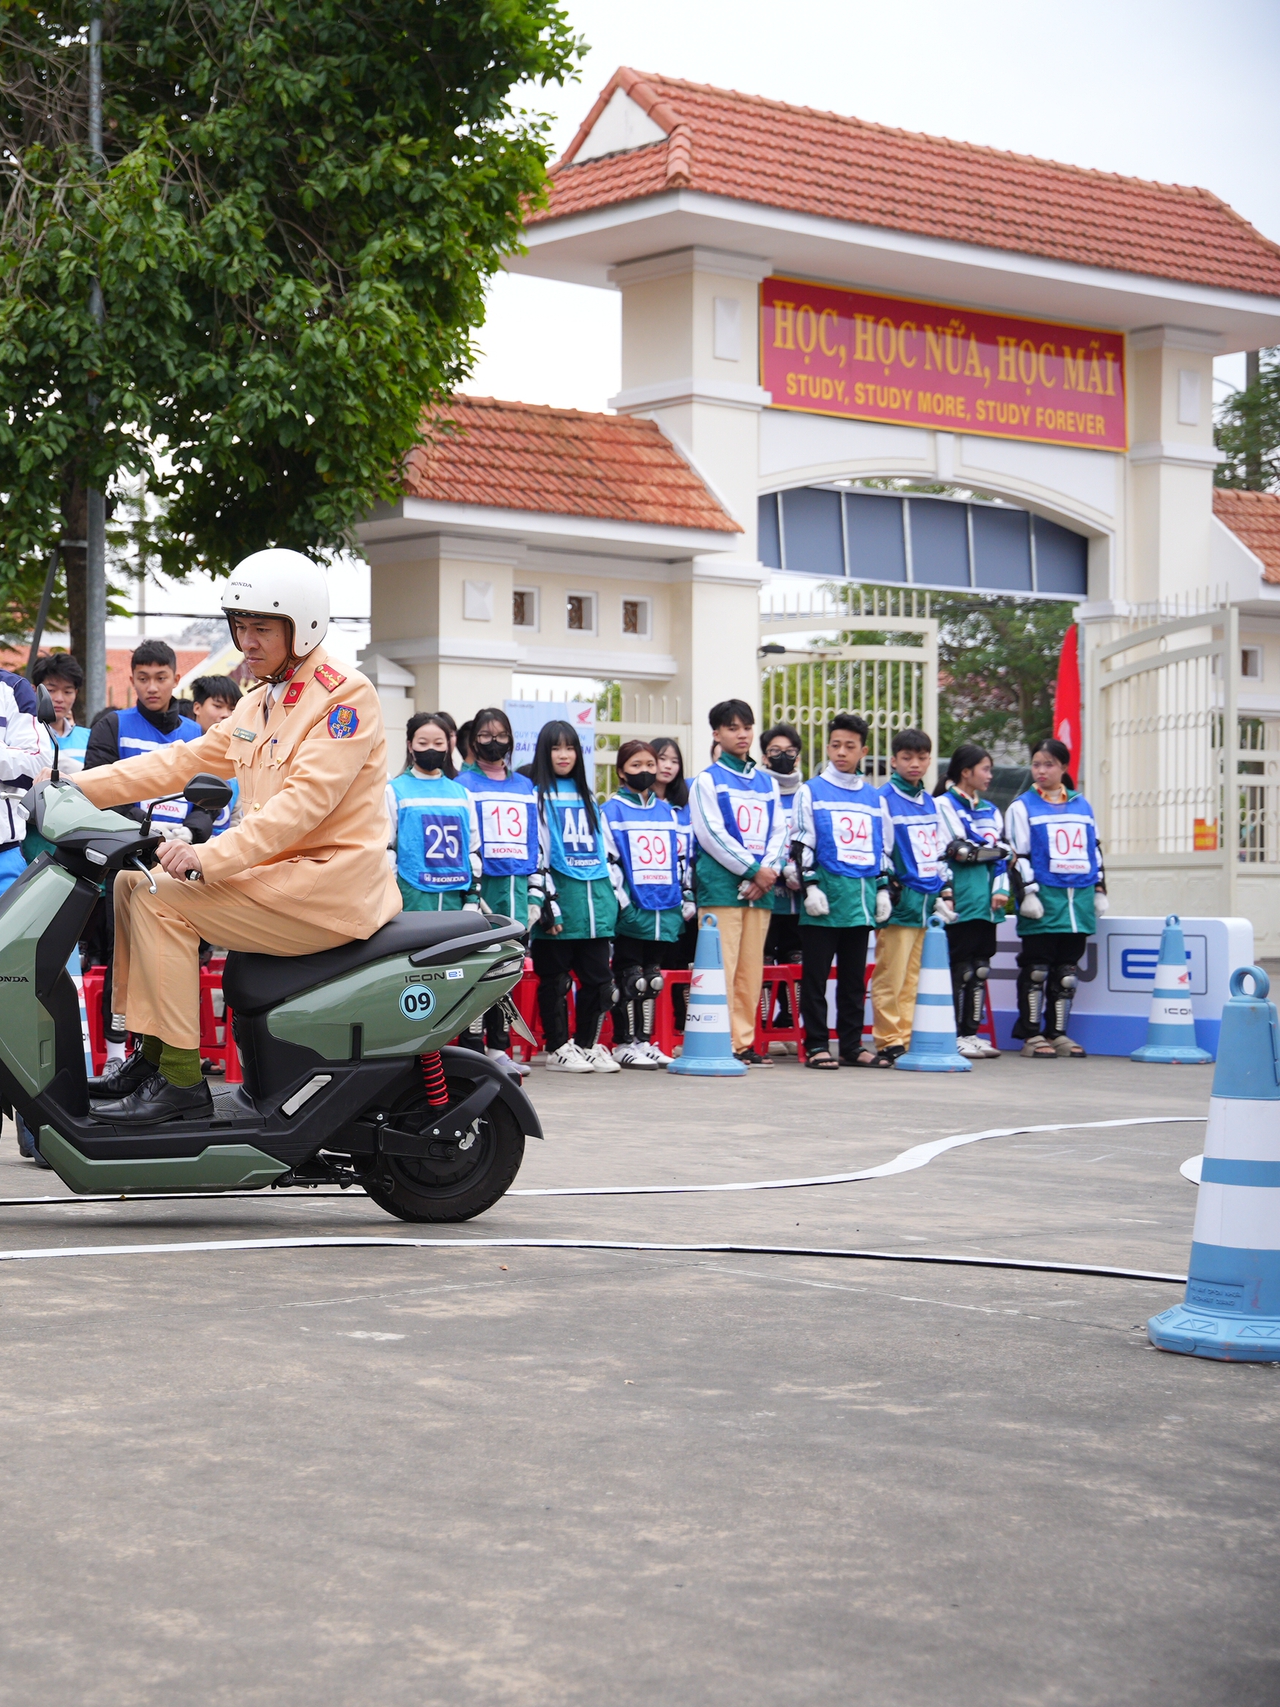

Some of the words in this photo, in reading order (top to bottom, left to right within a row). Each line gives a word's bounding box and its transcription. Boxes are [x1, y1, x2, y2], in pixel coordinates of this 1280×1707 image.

[773, 300, 847, 368] HỌC,
[853, 313, 917, 376] HỌC
[996, 336, 1057, 396] HỌC
[1062, 340, 1116, 396] MÃI
[786, 372, 849, 405] STUDY,
[854, 381, 913, 411] STUDY
[918, 390, 971, 422] MORE,
[976, 398, 1031, 426] STUDY
[1036, 407, 1106, 436] FOREVER
[491, 806, 522, 837] 13
[562, 808, 594, 852] 44
[840, 817, 867, 845] 34
[425, 824, 459, 858] 25
[637, 835, 666, 865] 39
[1055, 828, 1083, 855] 04
[432, 875, 466, 883] HONDA
[405, 972, 445, 983] ICON
[404, 992, 431, 1013] 09
